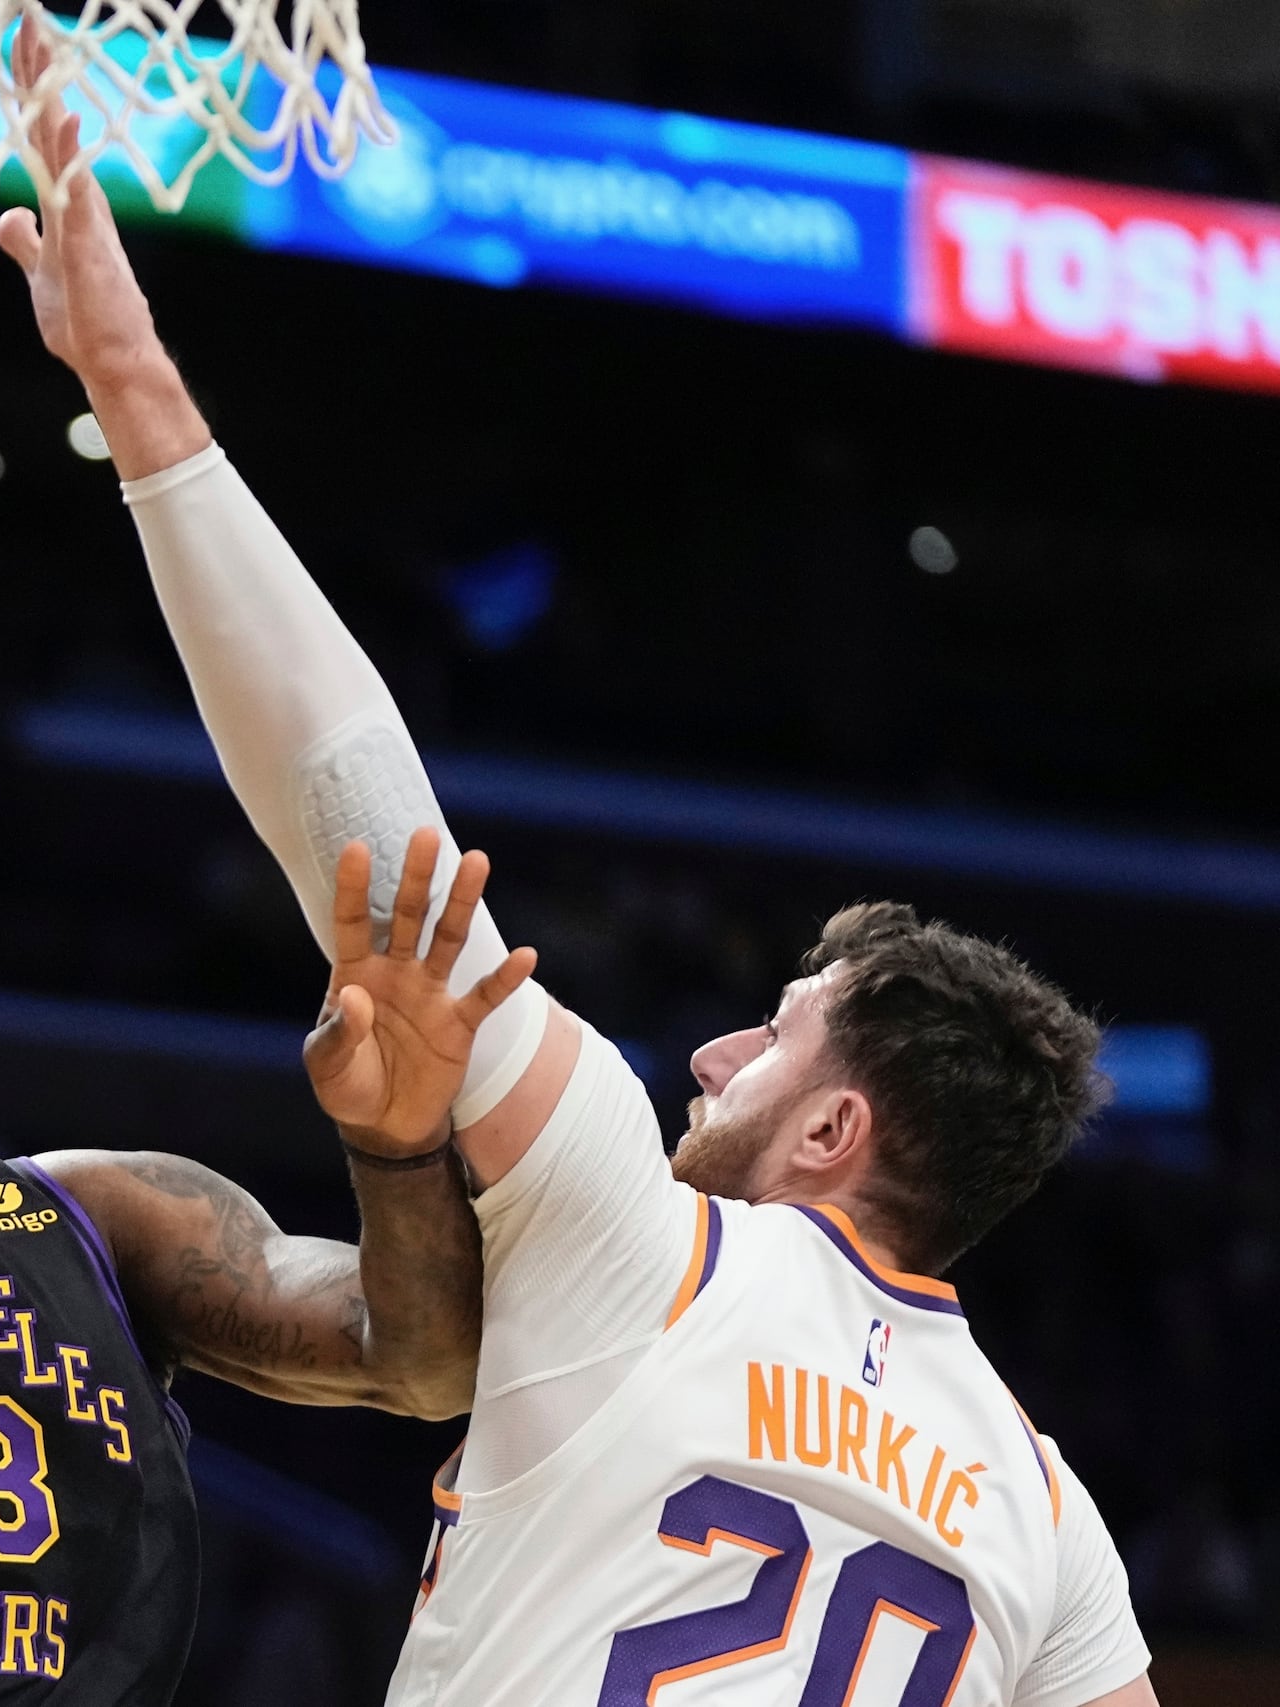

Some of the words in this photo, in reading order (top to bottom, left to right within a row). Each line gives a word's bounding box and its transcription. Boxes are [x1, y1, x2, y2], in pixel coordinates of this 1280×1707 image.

[439, 142, 862, 270] crypto.com
[747, 1361, 988, 1548] NURKIĆ
[596, 1473, 978, 1707] 20
